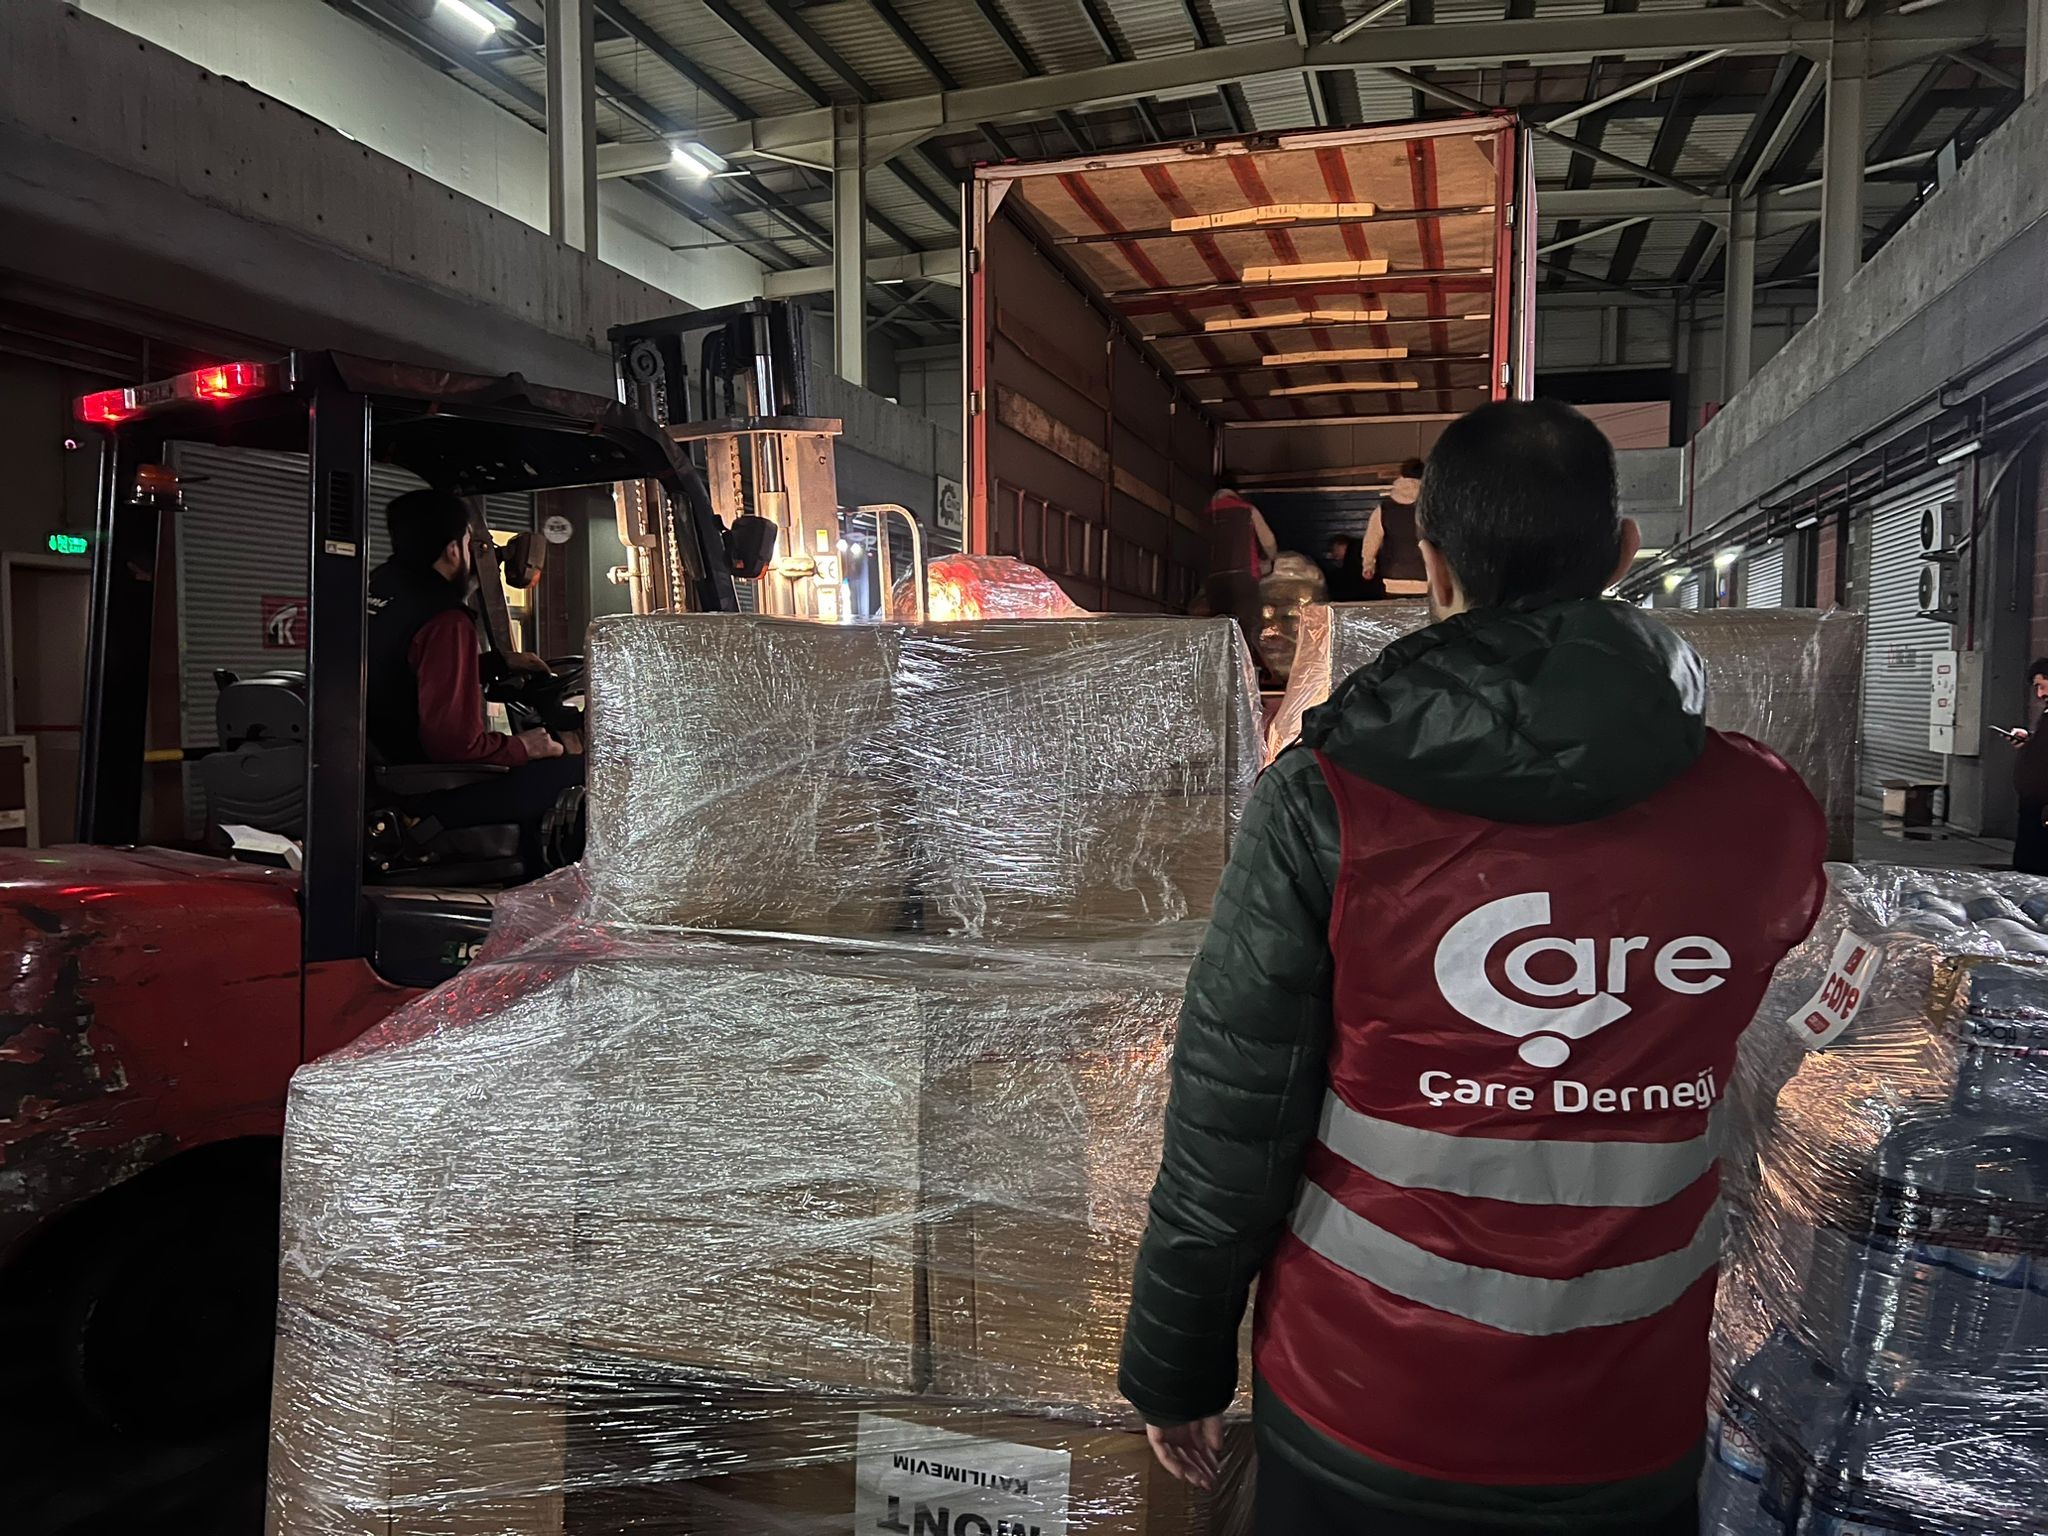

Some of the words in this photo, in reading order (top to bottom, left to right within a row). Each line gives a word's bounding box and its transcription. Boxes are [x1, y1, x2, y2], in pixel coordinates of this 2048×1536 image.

[1419, 1070, 1535, 1111] Çare
[1553, 1066, 1718, 1113] Derneği
[893, 1454, 1029, 1495] KATILIMEVİM
